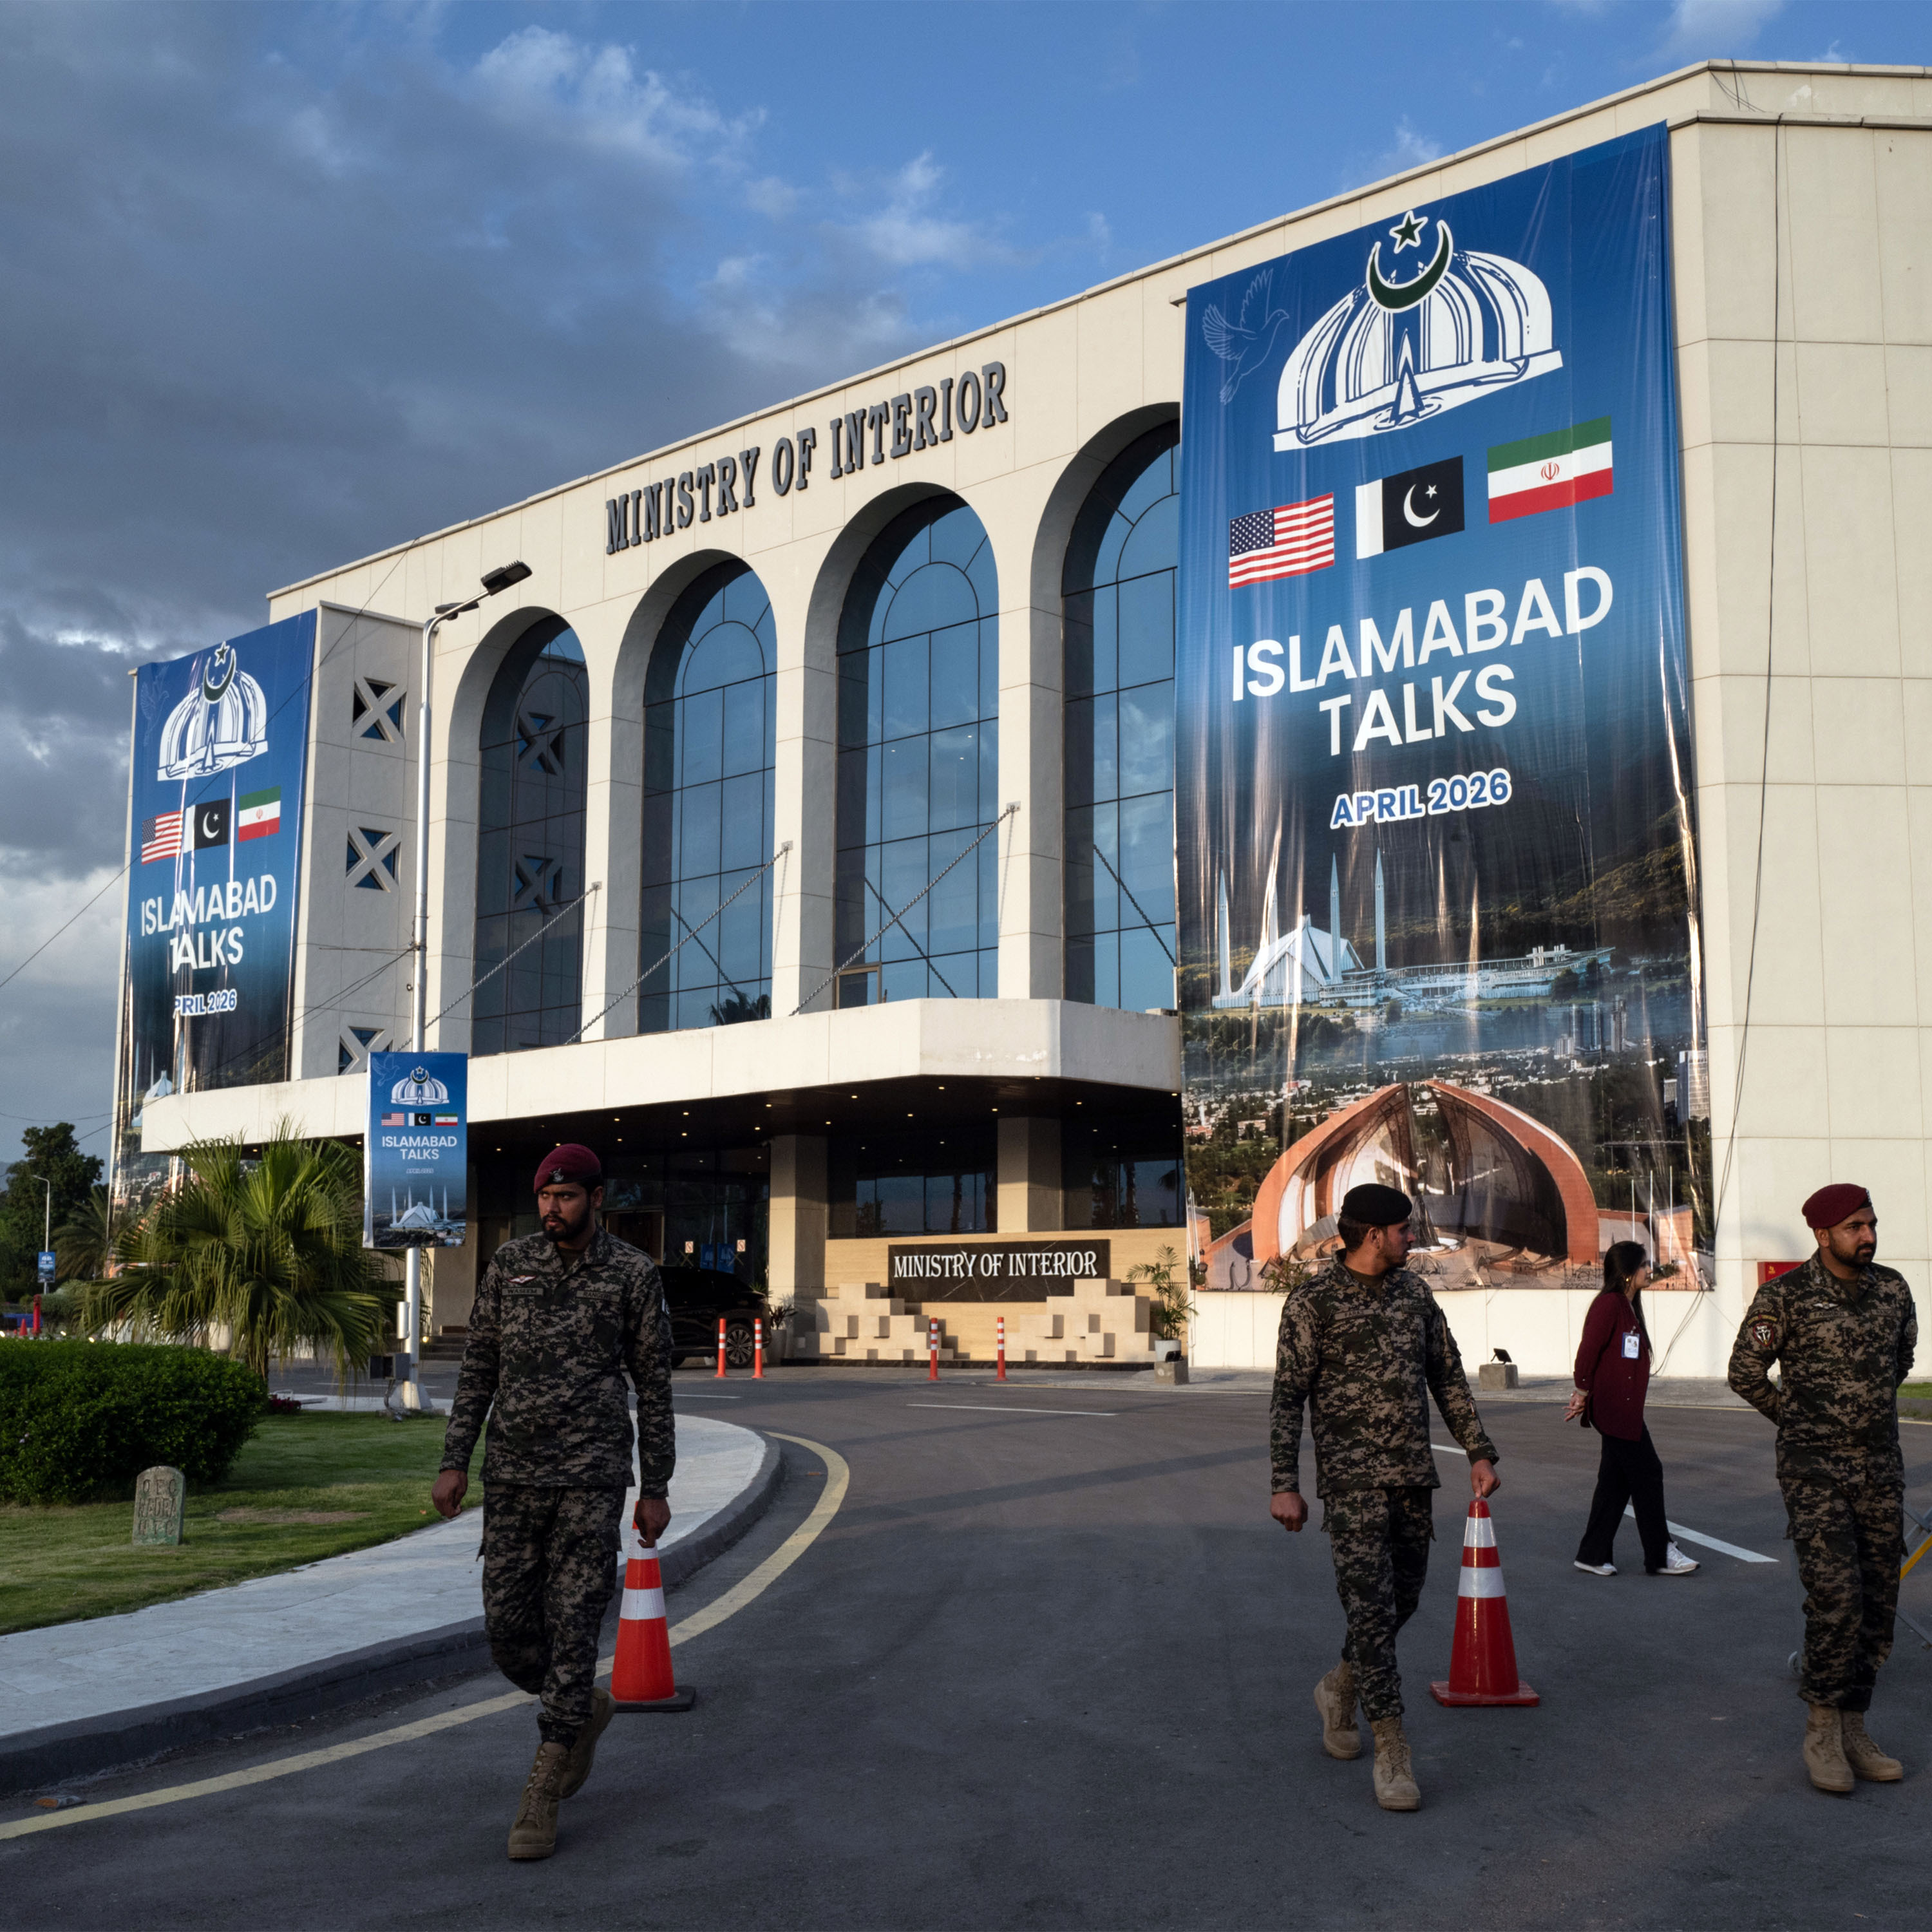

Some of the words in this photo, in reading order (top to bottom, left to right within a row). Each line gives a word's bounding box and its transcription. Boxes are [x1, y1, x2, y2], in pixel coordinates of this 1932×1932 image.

[606, 446, 760, 554] MINISTRY
[772, 427, 817, 496] OF
[830, 361, 1009, 479] INTERIOR
[1233, 566, 1613, 701] ISLAMABAD
[1319, 664, 1517, 756] TALKS
[1330, 785, 1425, 829] APRIL
[1427, 768, 1512, 816] 2026
[142, 874, 277, 936] ISLAMABAD
[170, 926, 243, 974] TALKS
[173, 994, 207, 1019] PRIL
[207, 989, 237, 1014] 2026
[382, 1136, 457, 1148] ISLAMABAD
[400, 1148, 440, 1160] TALKS
[894, 1251, 977, 1278] MINISTRY
[980, 1253, 1004, 1277] OF
[1009, 1251, 1097, 1278] INTERIOR
